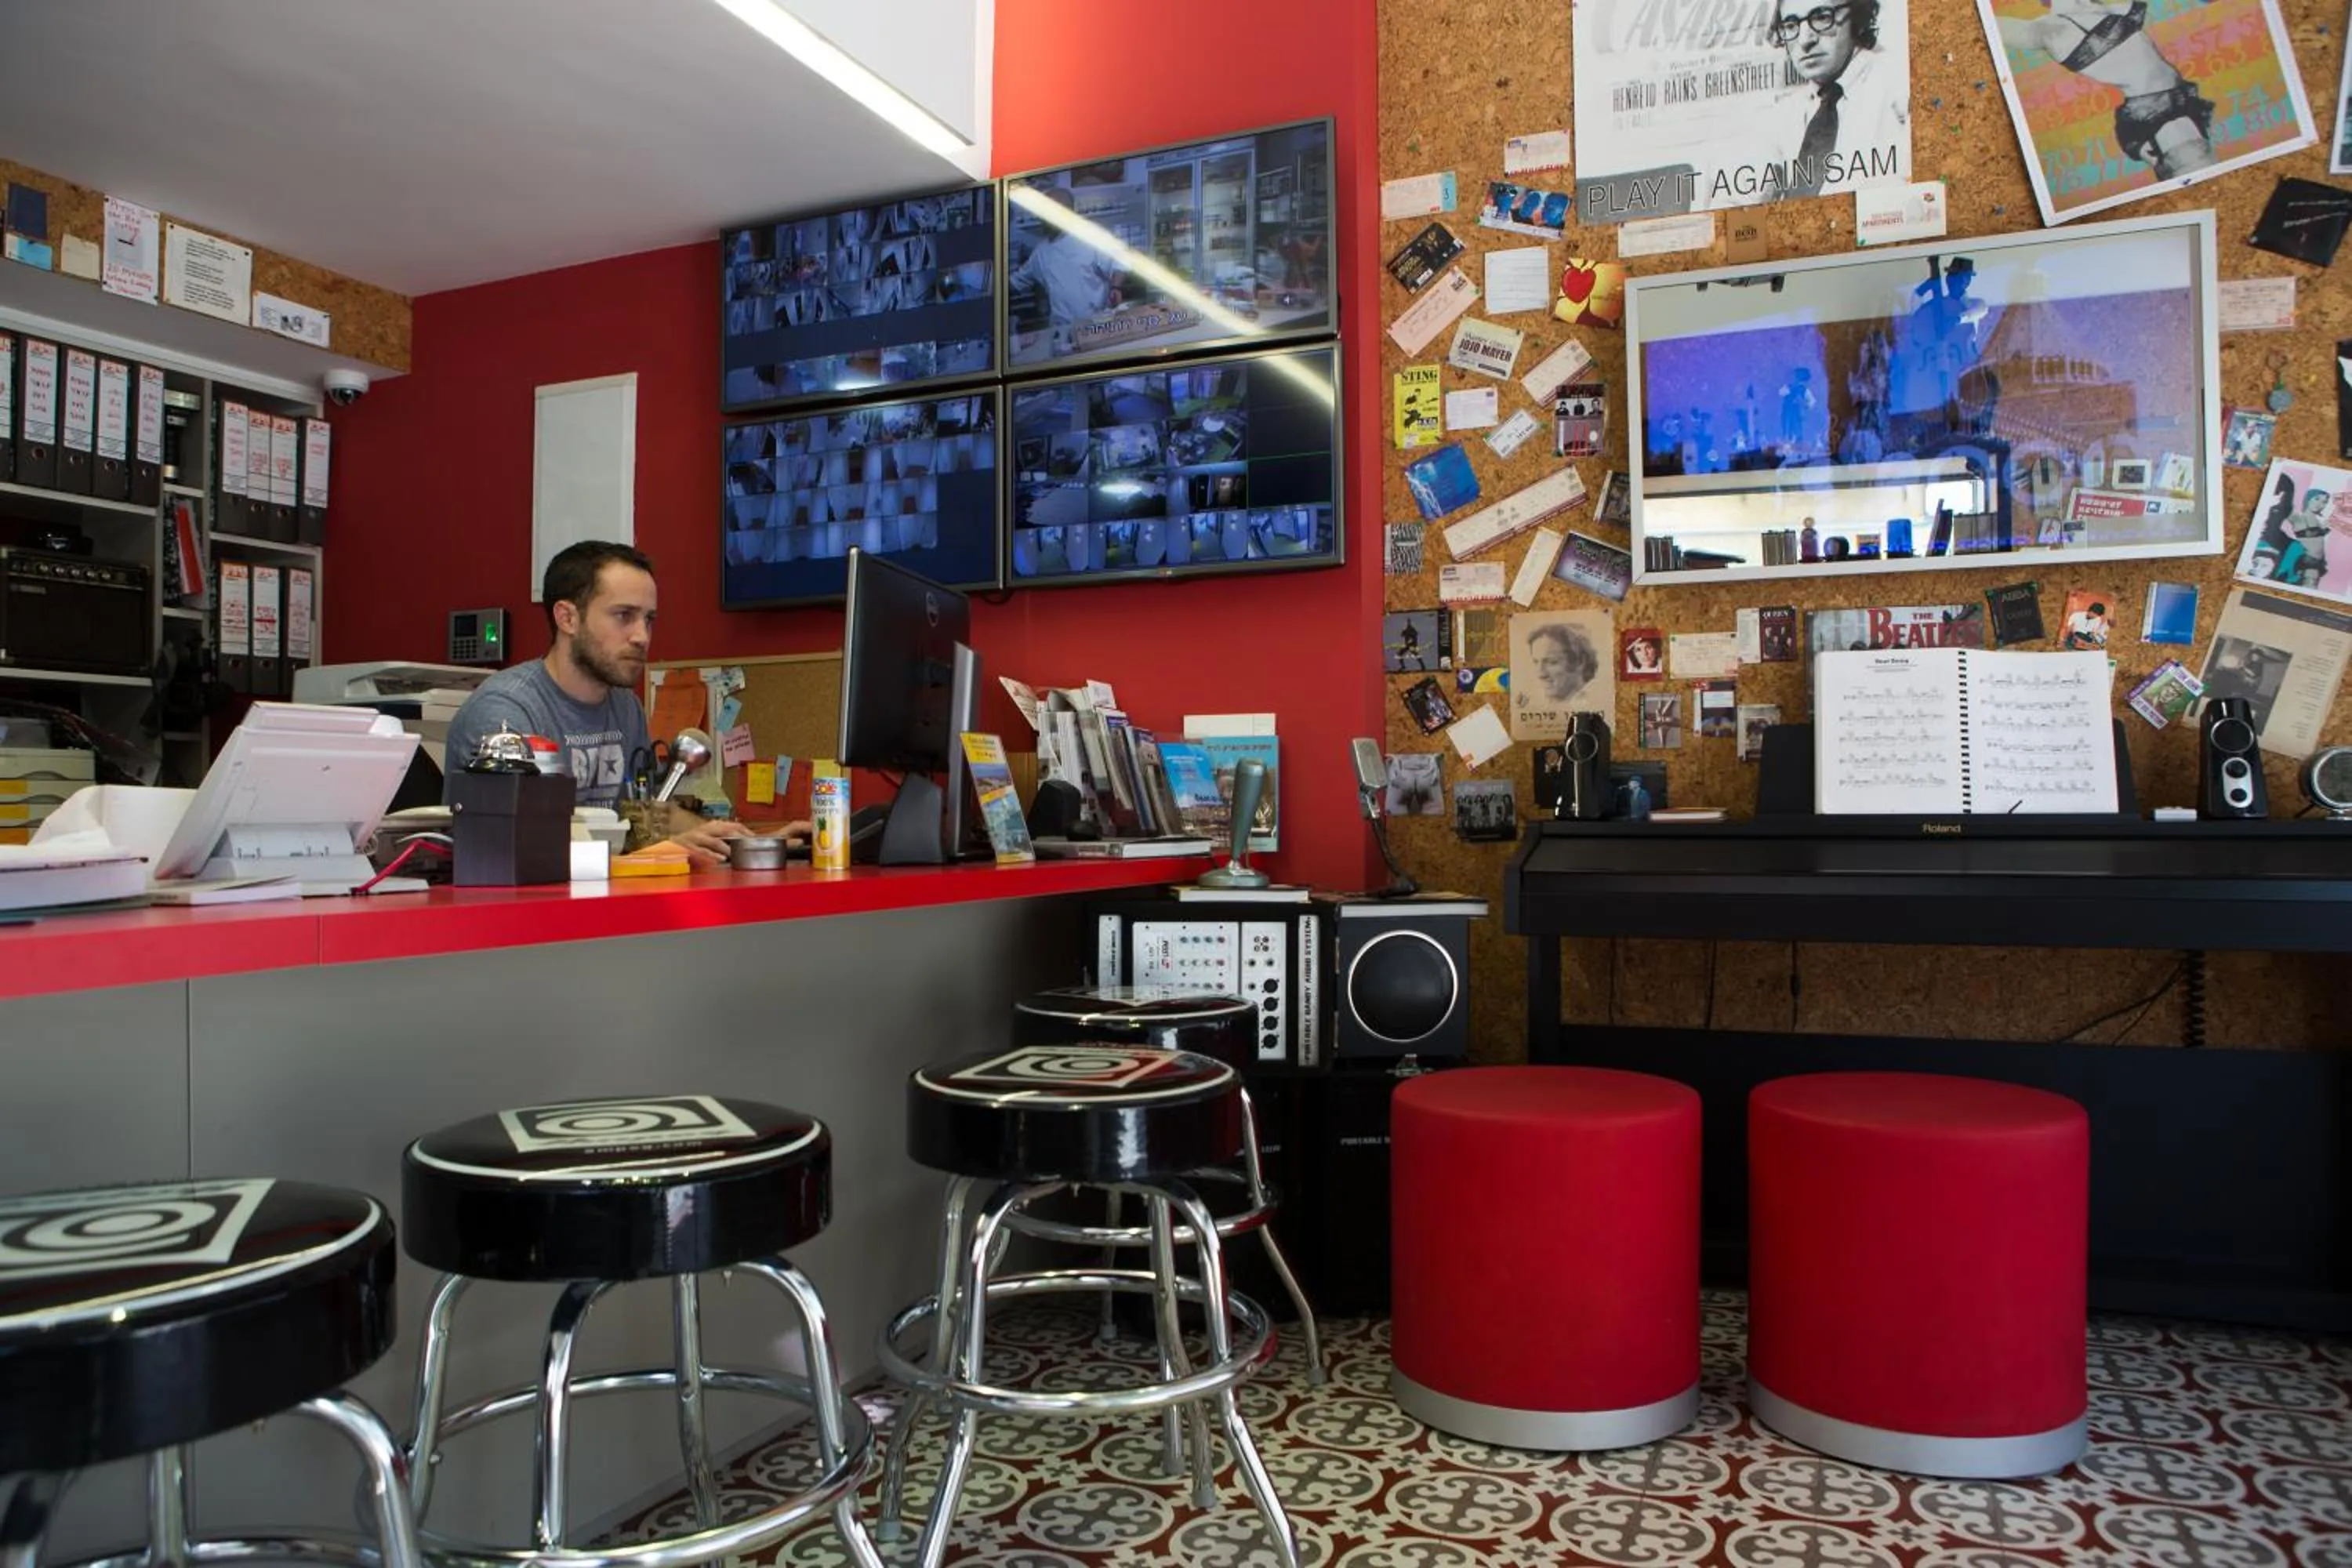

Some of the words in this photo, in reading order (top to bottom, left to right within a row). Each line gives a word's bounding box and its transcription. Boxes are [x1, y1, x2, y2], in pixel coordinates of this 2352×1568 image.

[1613, 82, 1656, 112] HENREID
[1664, 75, 1697, 105] RAINS
[1704, 62, 1775, 98] GREENSTREET
[1588, 176, 1665, 216] PLAY
[1676, 172, 1703, 205] IT
[1712, 156, 1814, 198] AGAIN
[1824, 144, 1897, 183] SAM
[1457, 338, 1480, 354] JOJO
[1481, 345, 1512, 363] MAYER
[1401, 370, 1438, 382] STING
[1922, 823, 1961, 833] Roland
